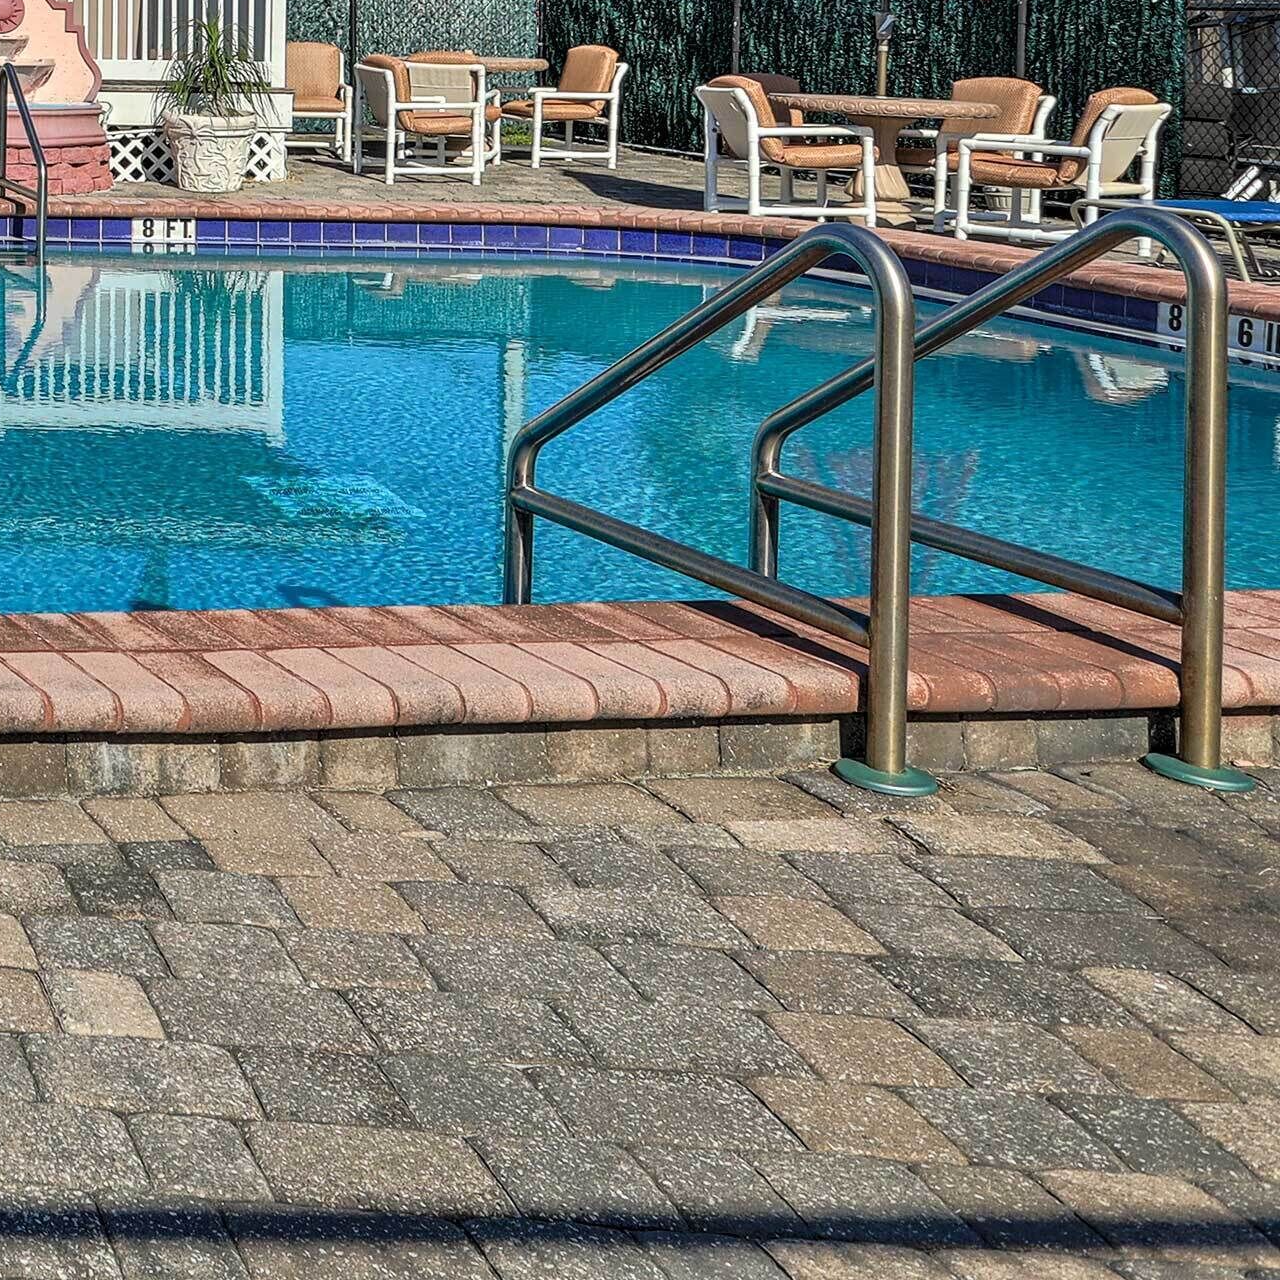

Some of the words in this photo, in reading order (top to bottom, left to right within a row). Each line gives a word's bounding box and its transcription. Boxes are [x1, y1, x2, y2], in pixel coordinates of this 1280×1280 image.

[142, 218, 154, 238] 8
[166, 218, 192, 239] FT.
[1168, 304, 1182, 331] 8
[1238, 318, 1254, 348] 6
